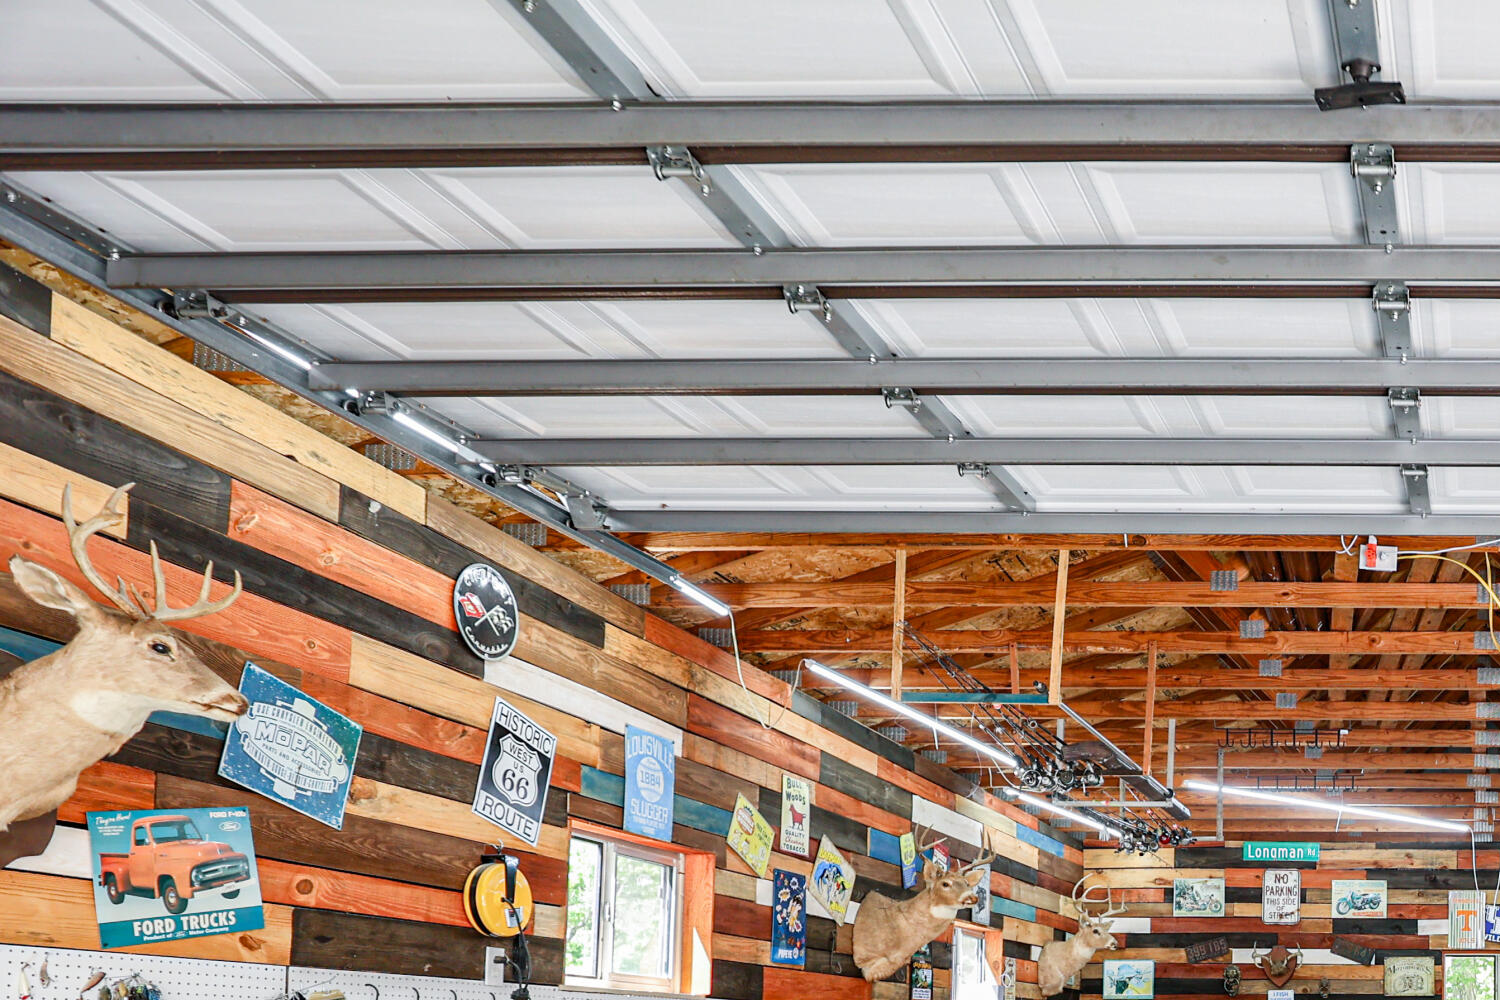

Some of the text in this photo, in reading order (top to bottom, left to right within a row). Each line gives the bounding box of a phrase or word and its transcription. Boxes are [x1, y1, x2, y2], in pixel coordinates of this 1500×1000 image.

[499, 706, 552, 754] HISTORIC
[509, 742, 534, 764] WEST
[627, 735, 674, 774] LOUISVILLE
[513, 761, 524, 774] US
[502, 768, 529, 800] 66
[639, 769, 661, 790] 1884
[482, 795, 534, 837] ROUTE
[1307, 848, 1316, 856] Rd
[1274, 873, 1289, 885] NO
[1265, 886, 1297, 897] PARKING
[133, 910, 237, 938] FORD TRUCKS
[1456, 909, 1478, 932] T
